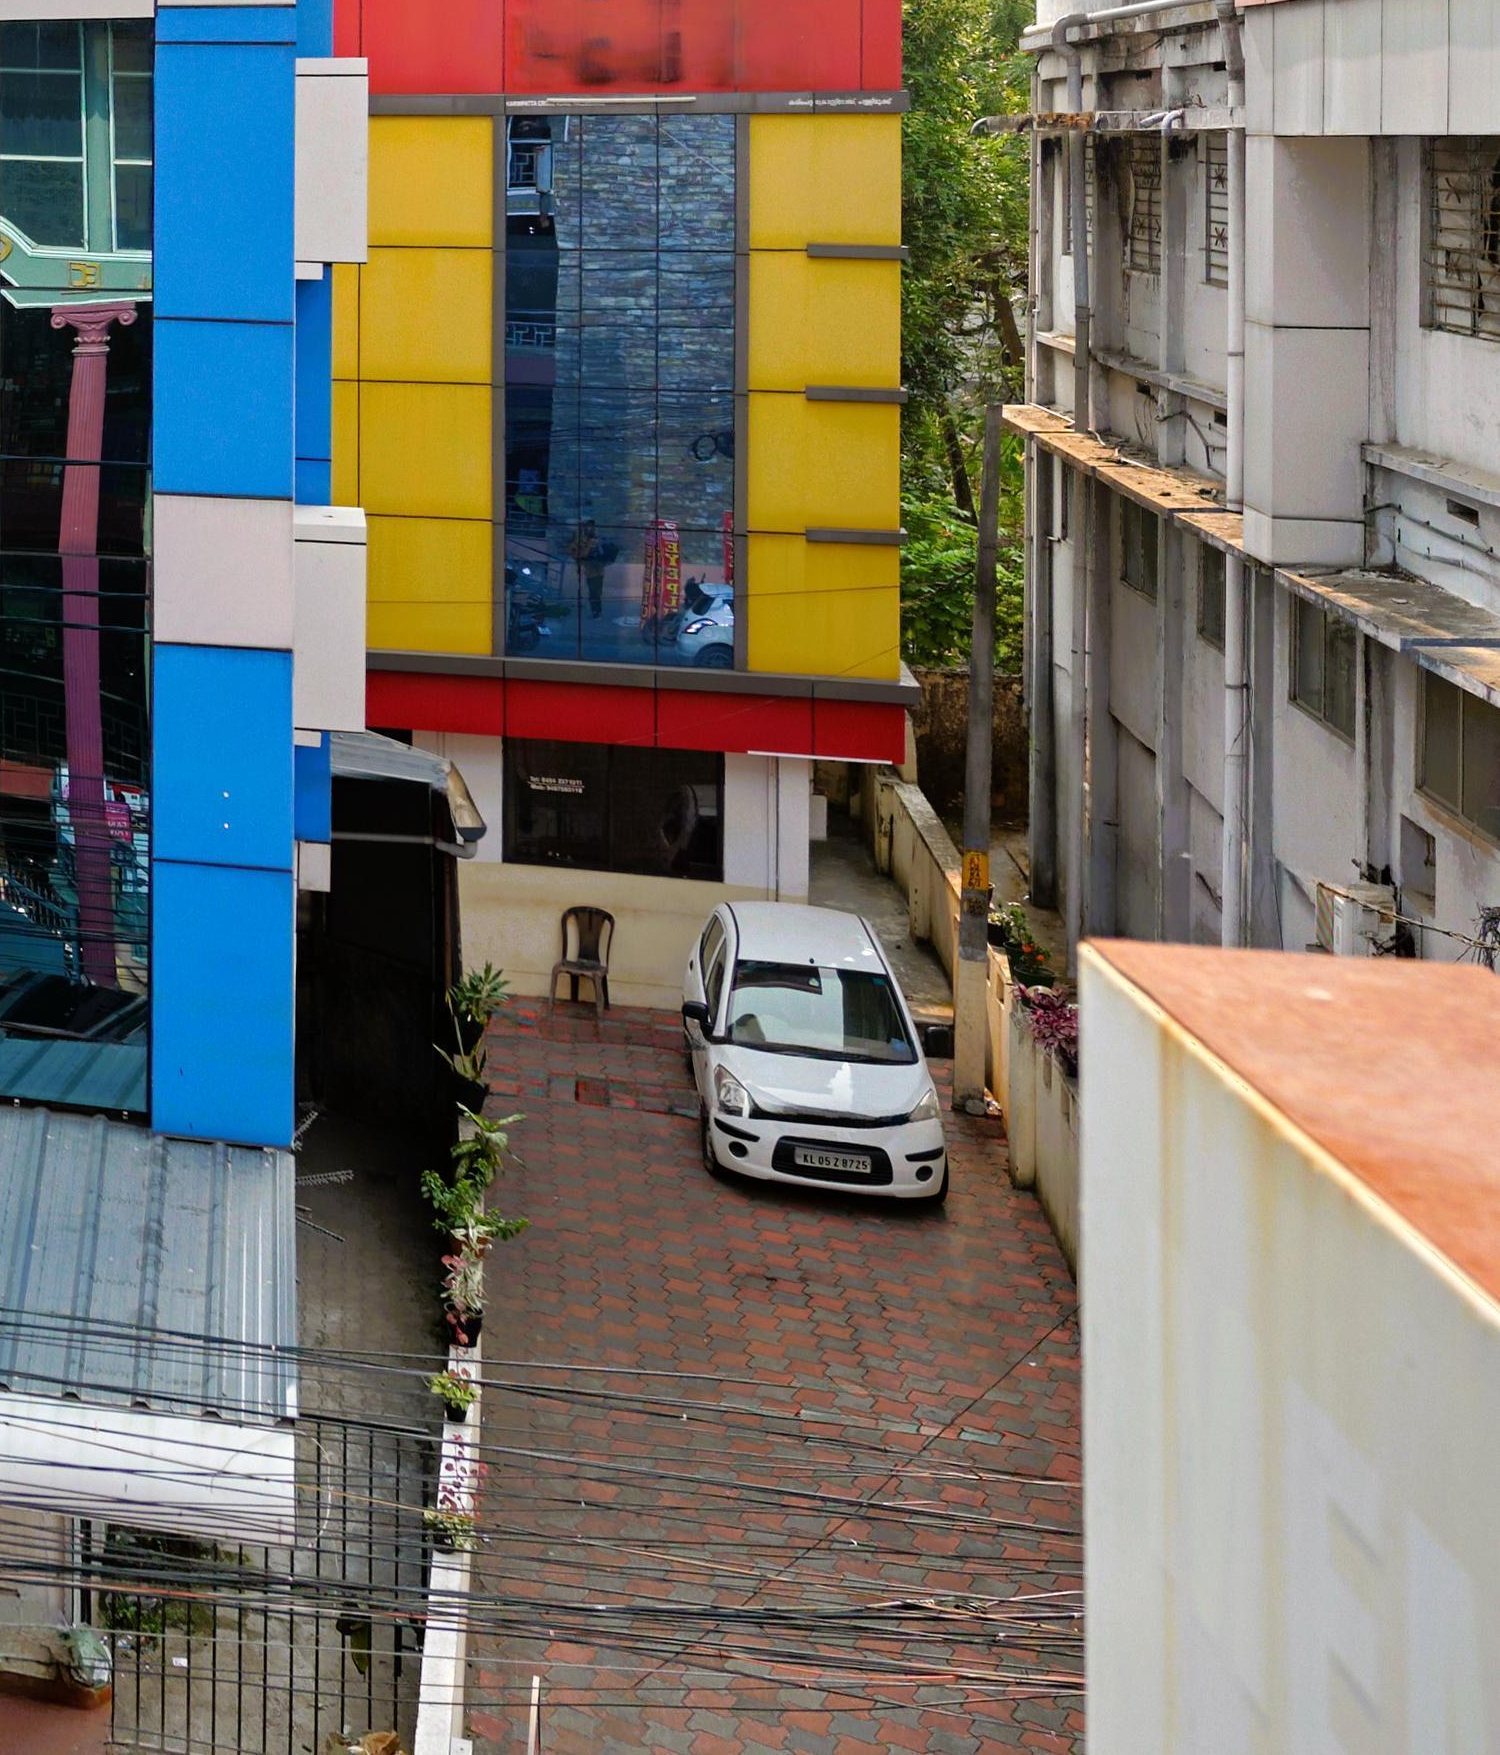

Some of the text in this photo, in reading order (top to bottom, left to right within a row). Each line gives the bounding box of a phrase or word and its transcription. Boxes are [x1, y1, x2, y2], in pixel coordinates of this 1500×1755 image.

[803, 1153, 868, 1170] KL 05 Z 8725
